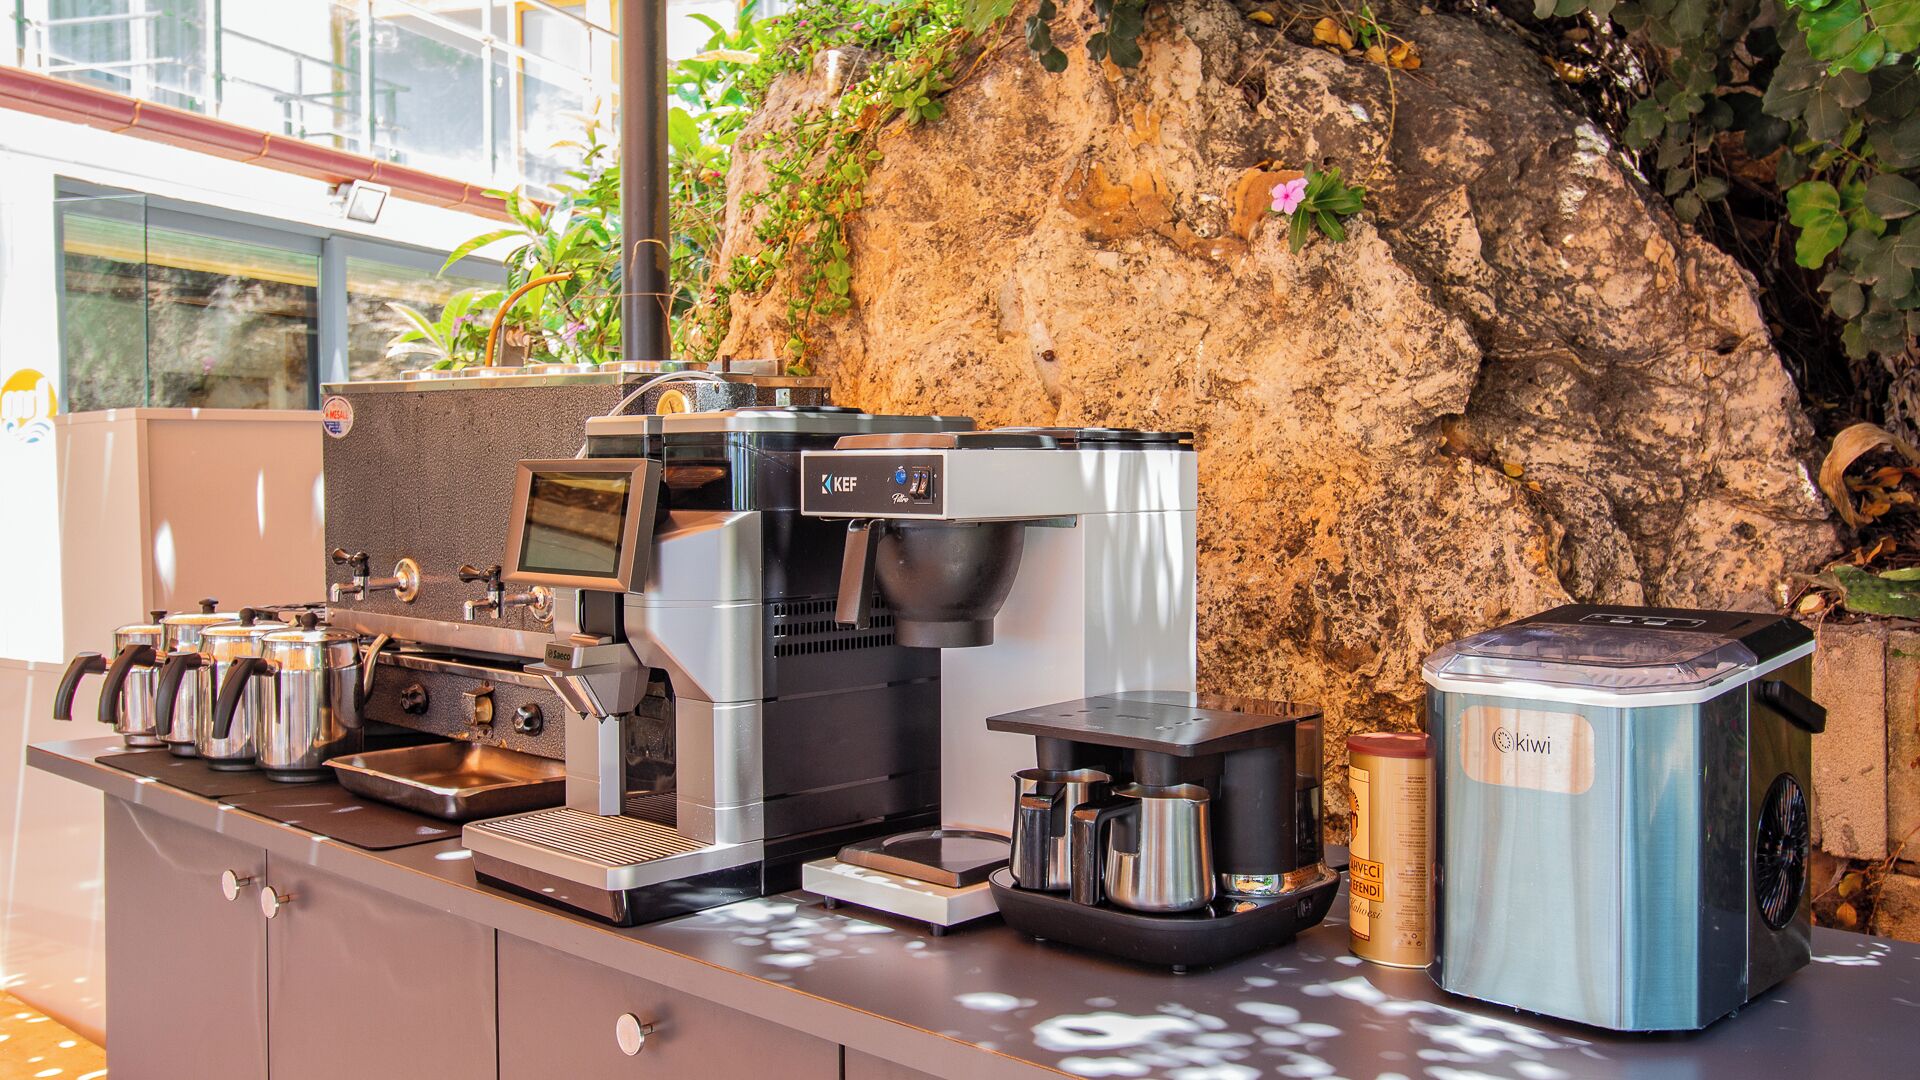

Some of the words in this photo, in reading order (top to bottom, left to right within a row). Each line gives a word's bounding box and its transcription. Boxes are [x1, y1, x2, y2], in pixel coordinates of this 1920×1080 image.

[834, 476, 858, 492] KEF
[553, 650, 571, 661] Saeco
[1516, 732, 1551, 755] kiwi
[1350, 858, 1380, 879] AHVECİ
